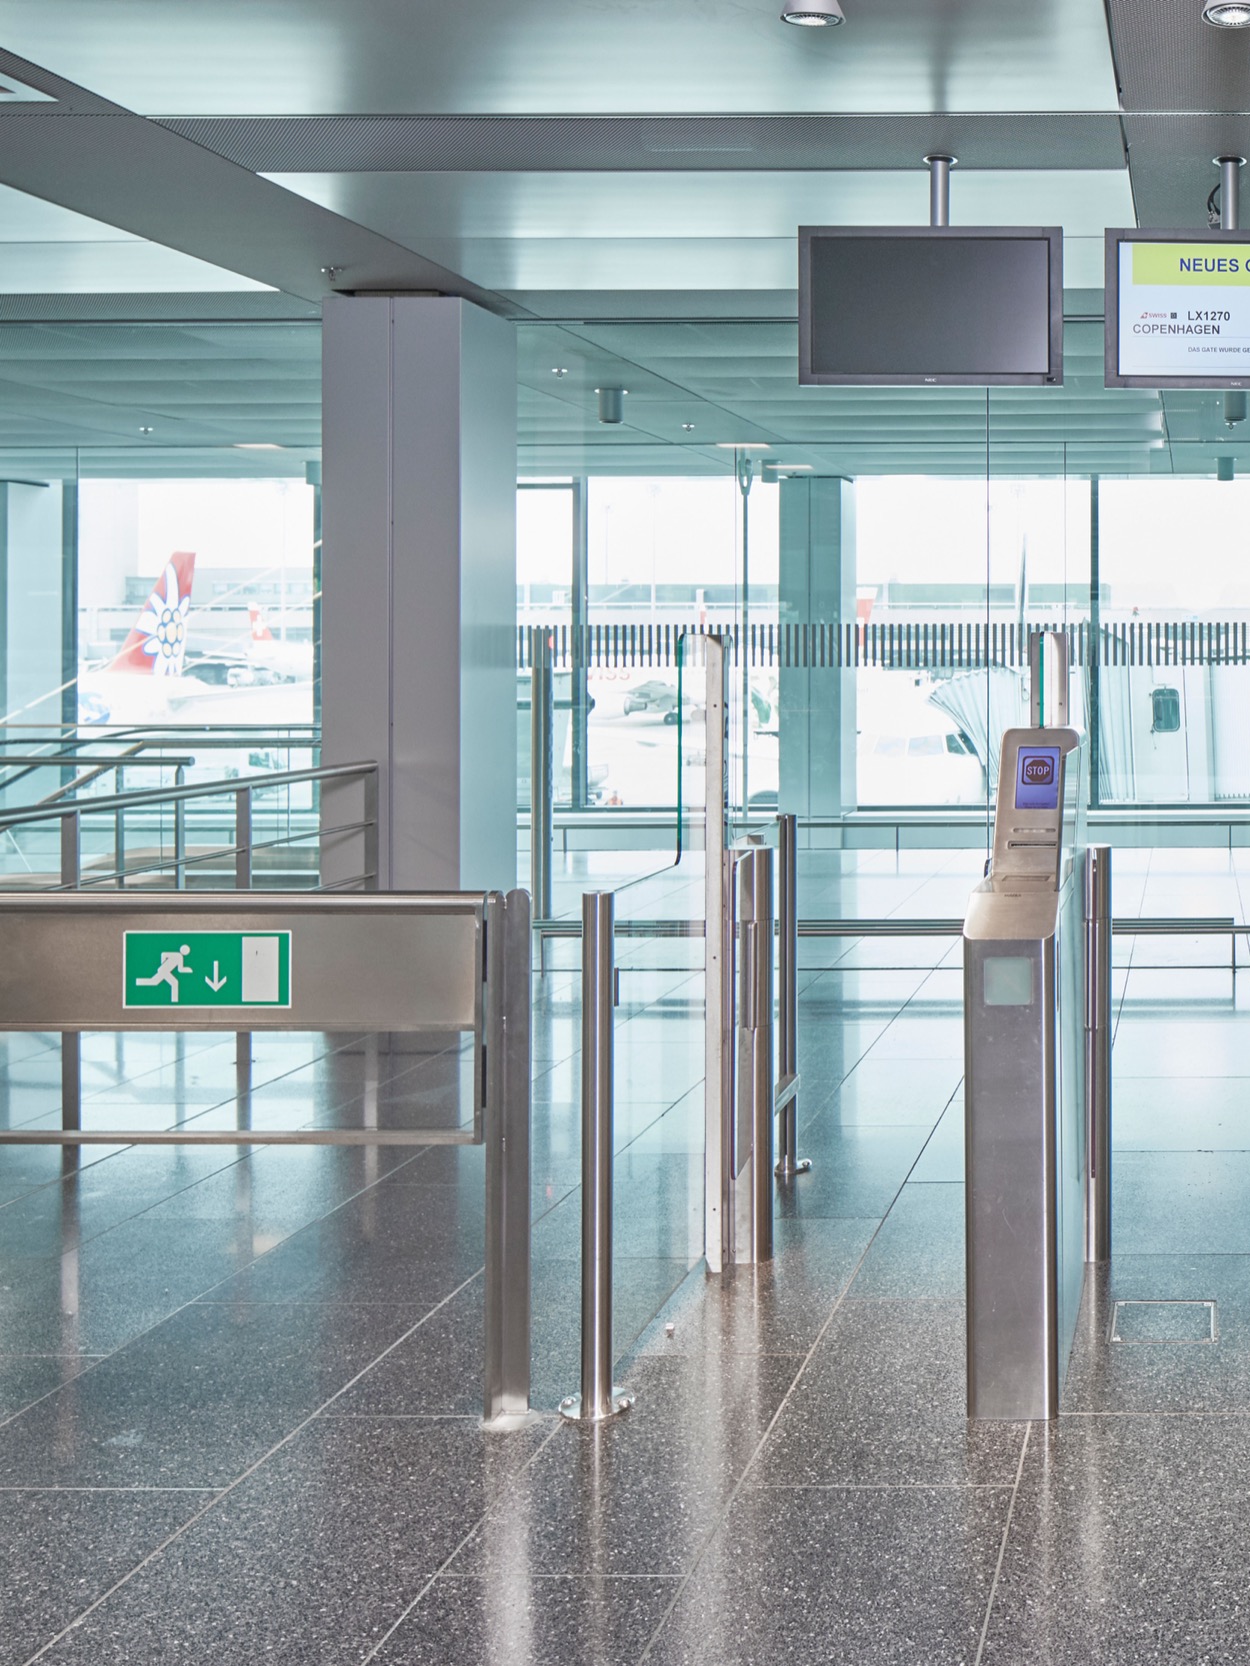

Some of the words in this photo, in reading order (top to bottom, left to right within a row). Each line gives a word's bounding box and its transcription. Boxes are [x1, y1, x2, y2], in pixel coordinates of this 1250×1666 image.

[1179, 258, 1239, 272] NEUES
[1187, 311, 1231, 321] LX1270
[1132, 323, 1220, 335] COPENHAGEN
[1026, 766, 1050, 776] STOP
